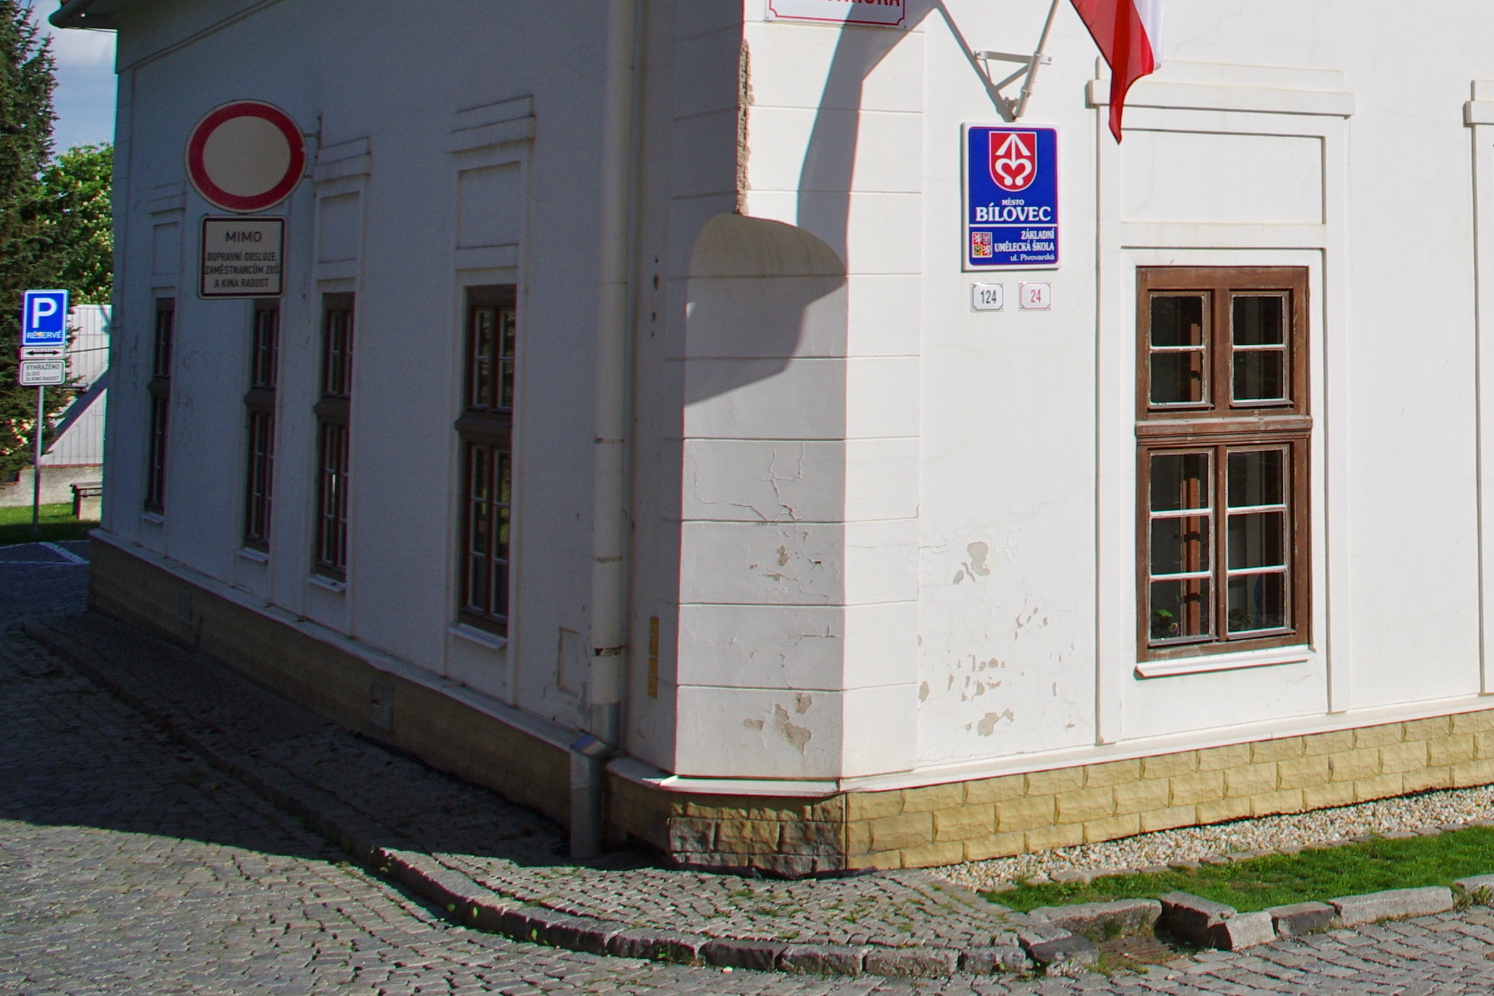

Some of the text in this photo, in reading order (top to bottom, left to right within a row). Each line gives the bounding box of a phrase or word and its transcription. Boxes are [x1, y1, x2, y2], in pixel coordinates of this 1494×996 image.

[1001, 198, 1025, 206] MĚSTO
[975, 202, 1052, 221] BÍLOVEC
[225, 231, 263, 242] MIMO
[1021, 228, 1055, 240] ZÁKLADNÍ
[994, 240, 1055, 252] UMĚLECKÁ ŠKOLA
[207, 251, 243, 262] DOPRAVNÍ
[1020, 253, 1055, 261] Pivovarská
[215, 278, 269, 288] A KINA RADOST
[980, 290, 997, 304] 124
[1030, 289, 1042, 303] 24
[32, 297, 58, 329] P
